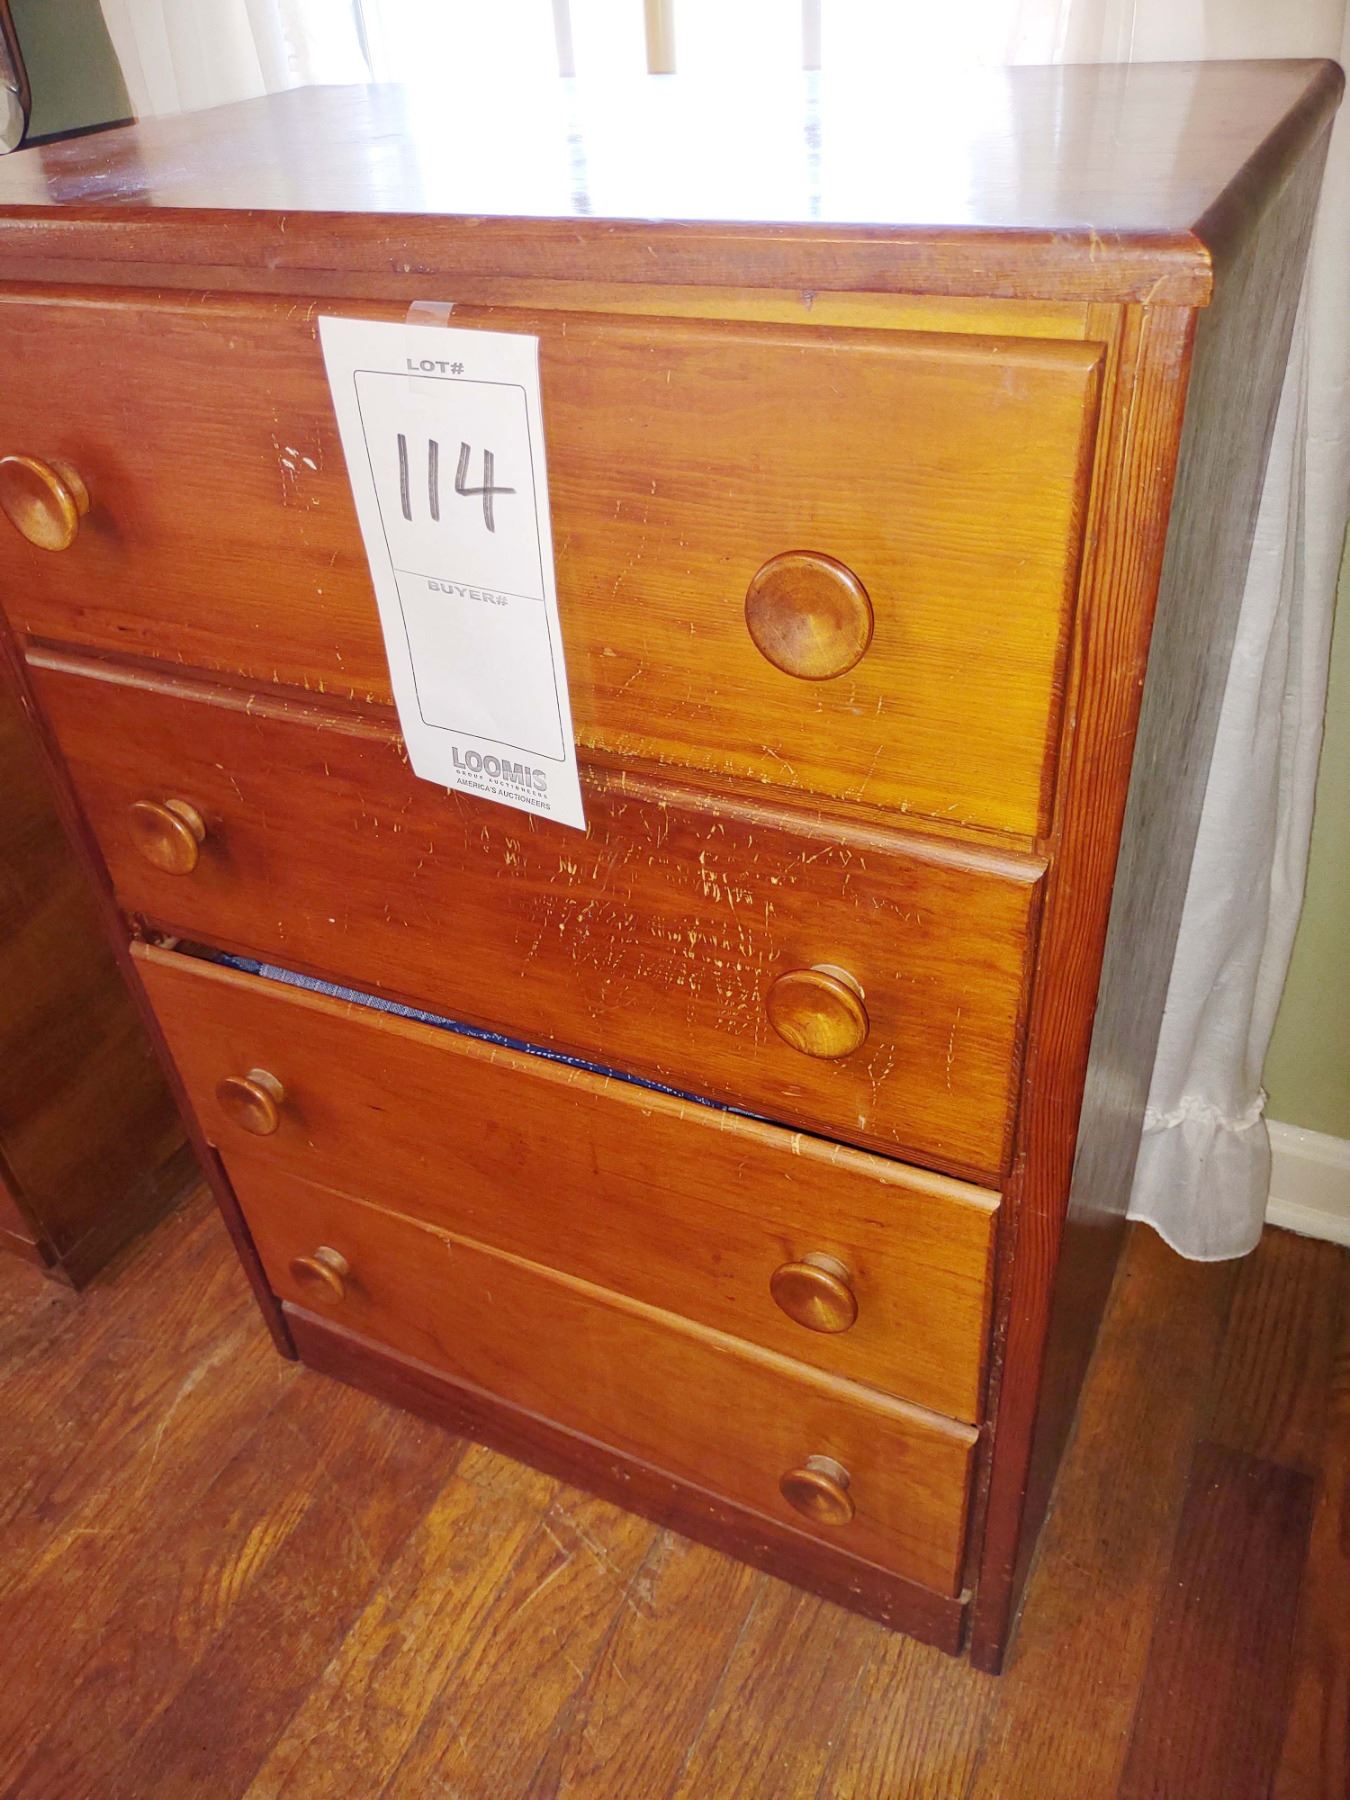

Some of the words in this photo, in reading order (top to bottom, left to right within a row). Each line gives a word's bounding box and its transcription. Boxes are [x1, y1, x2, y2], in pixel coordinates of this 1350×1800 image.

[406, 358, 465, 375] LOT#
[397, 433, 516, 533] 114
[427, 580, 509, 606] BUYER#
[452, 746, 548, 792] LOOMIS
[456, 777, 497, 794] AMERICA'S
[498, 789, 551, 810] AUCTIONEERS
